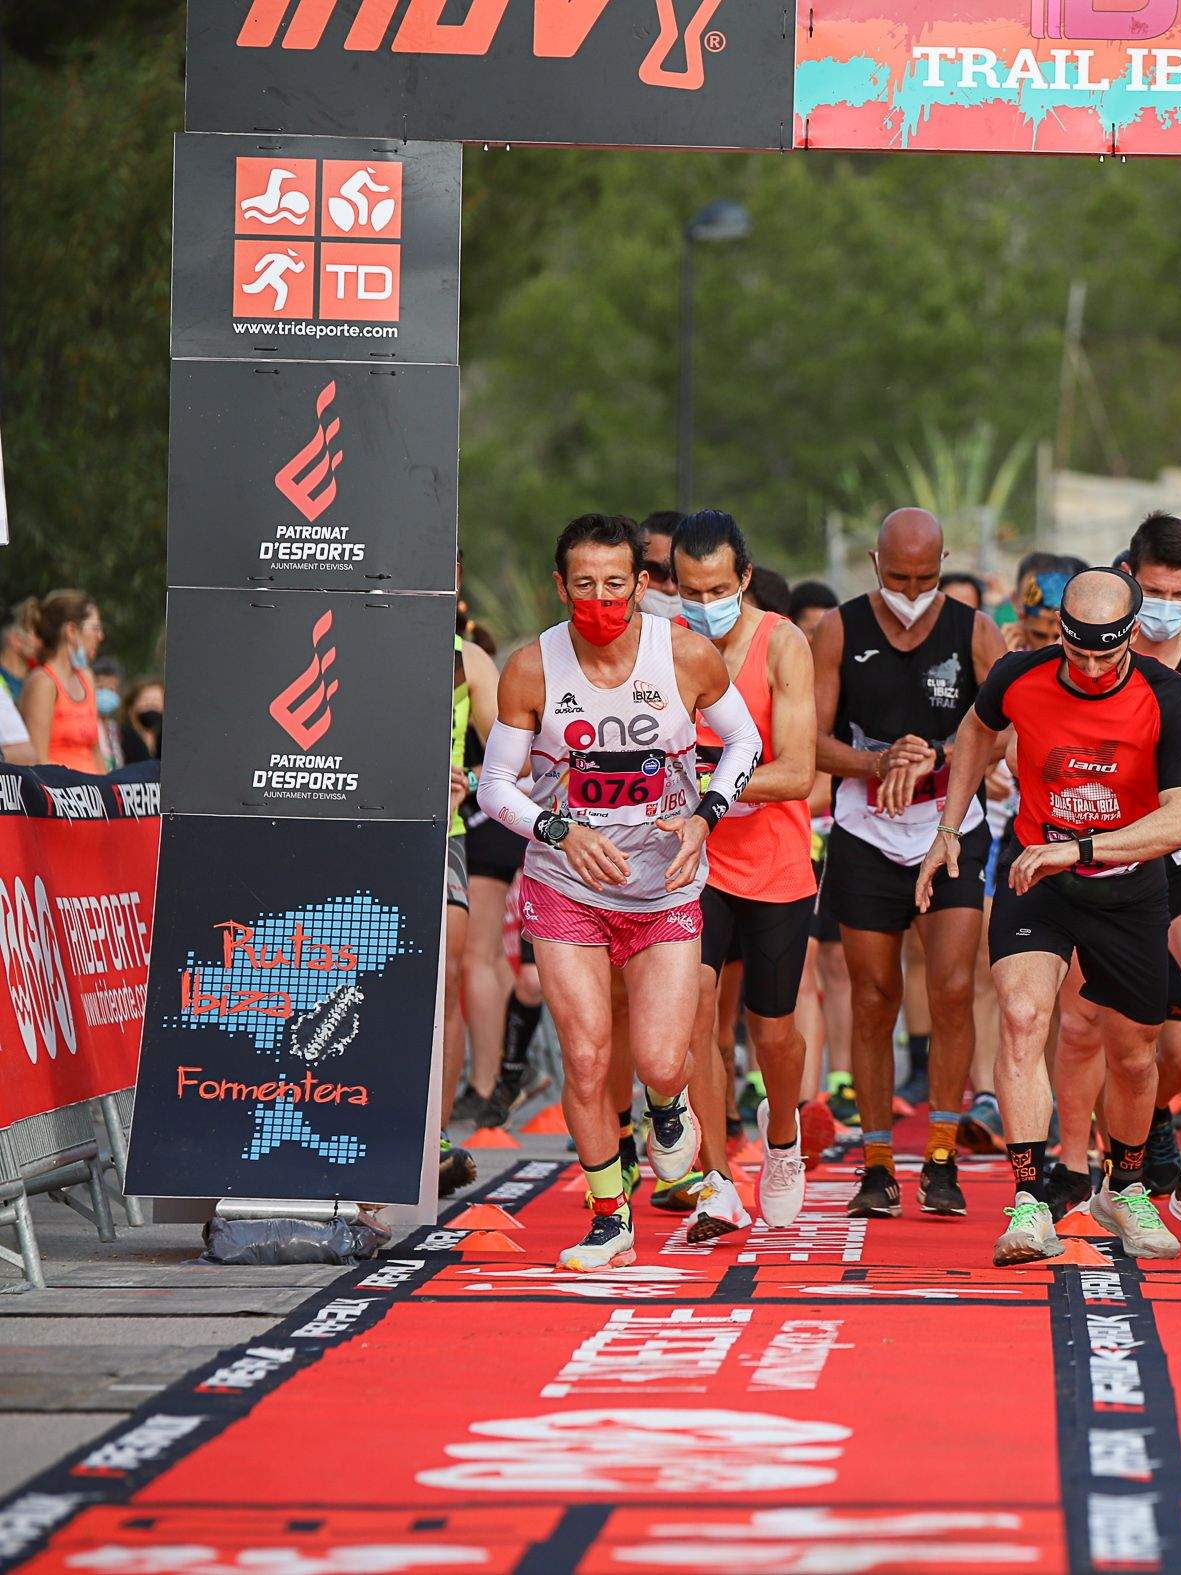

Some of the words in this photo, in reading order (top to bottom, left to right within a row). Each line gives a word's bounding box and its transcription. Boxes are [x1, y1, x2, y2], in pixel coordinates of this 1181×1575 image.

[912, 46, 1109, 92] TRAIL
[325, 263, 392, 301] TD
[232, 321, 399, 340] www.trideporte.com
[276, 526, 349, 540] PATRONAT
[259, 542, 365, 561] D'ESPORTS
[270, 563, 318, 571] AJUNTAMENT
[632, 690, 662, 702] IBIZA
[934, 687, 958, 698] IBIZA
[563, 713, 660, 751] one
[270, 755, 343, 770] PATRONAT
[1067, 758, 1118, 773] land
[252, 771, 359, 791] D'ESPORTS
[263, 791, 312, 800] AJUNTAMENT
[581, 777, 650, 805] 076
[112, 782, 161, 823] FIREHA
[1072, 797, 1097, 813] TRAIL
[1097, 798, 1120, 813] IBIZA
[55, 891, 150, 977] TRIDEPORTE
[213, 919, 358, 972] Rutas
[181, 969, 293, 1019] Ibiza
[176, 1065, 369, 1106] Formentera
